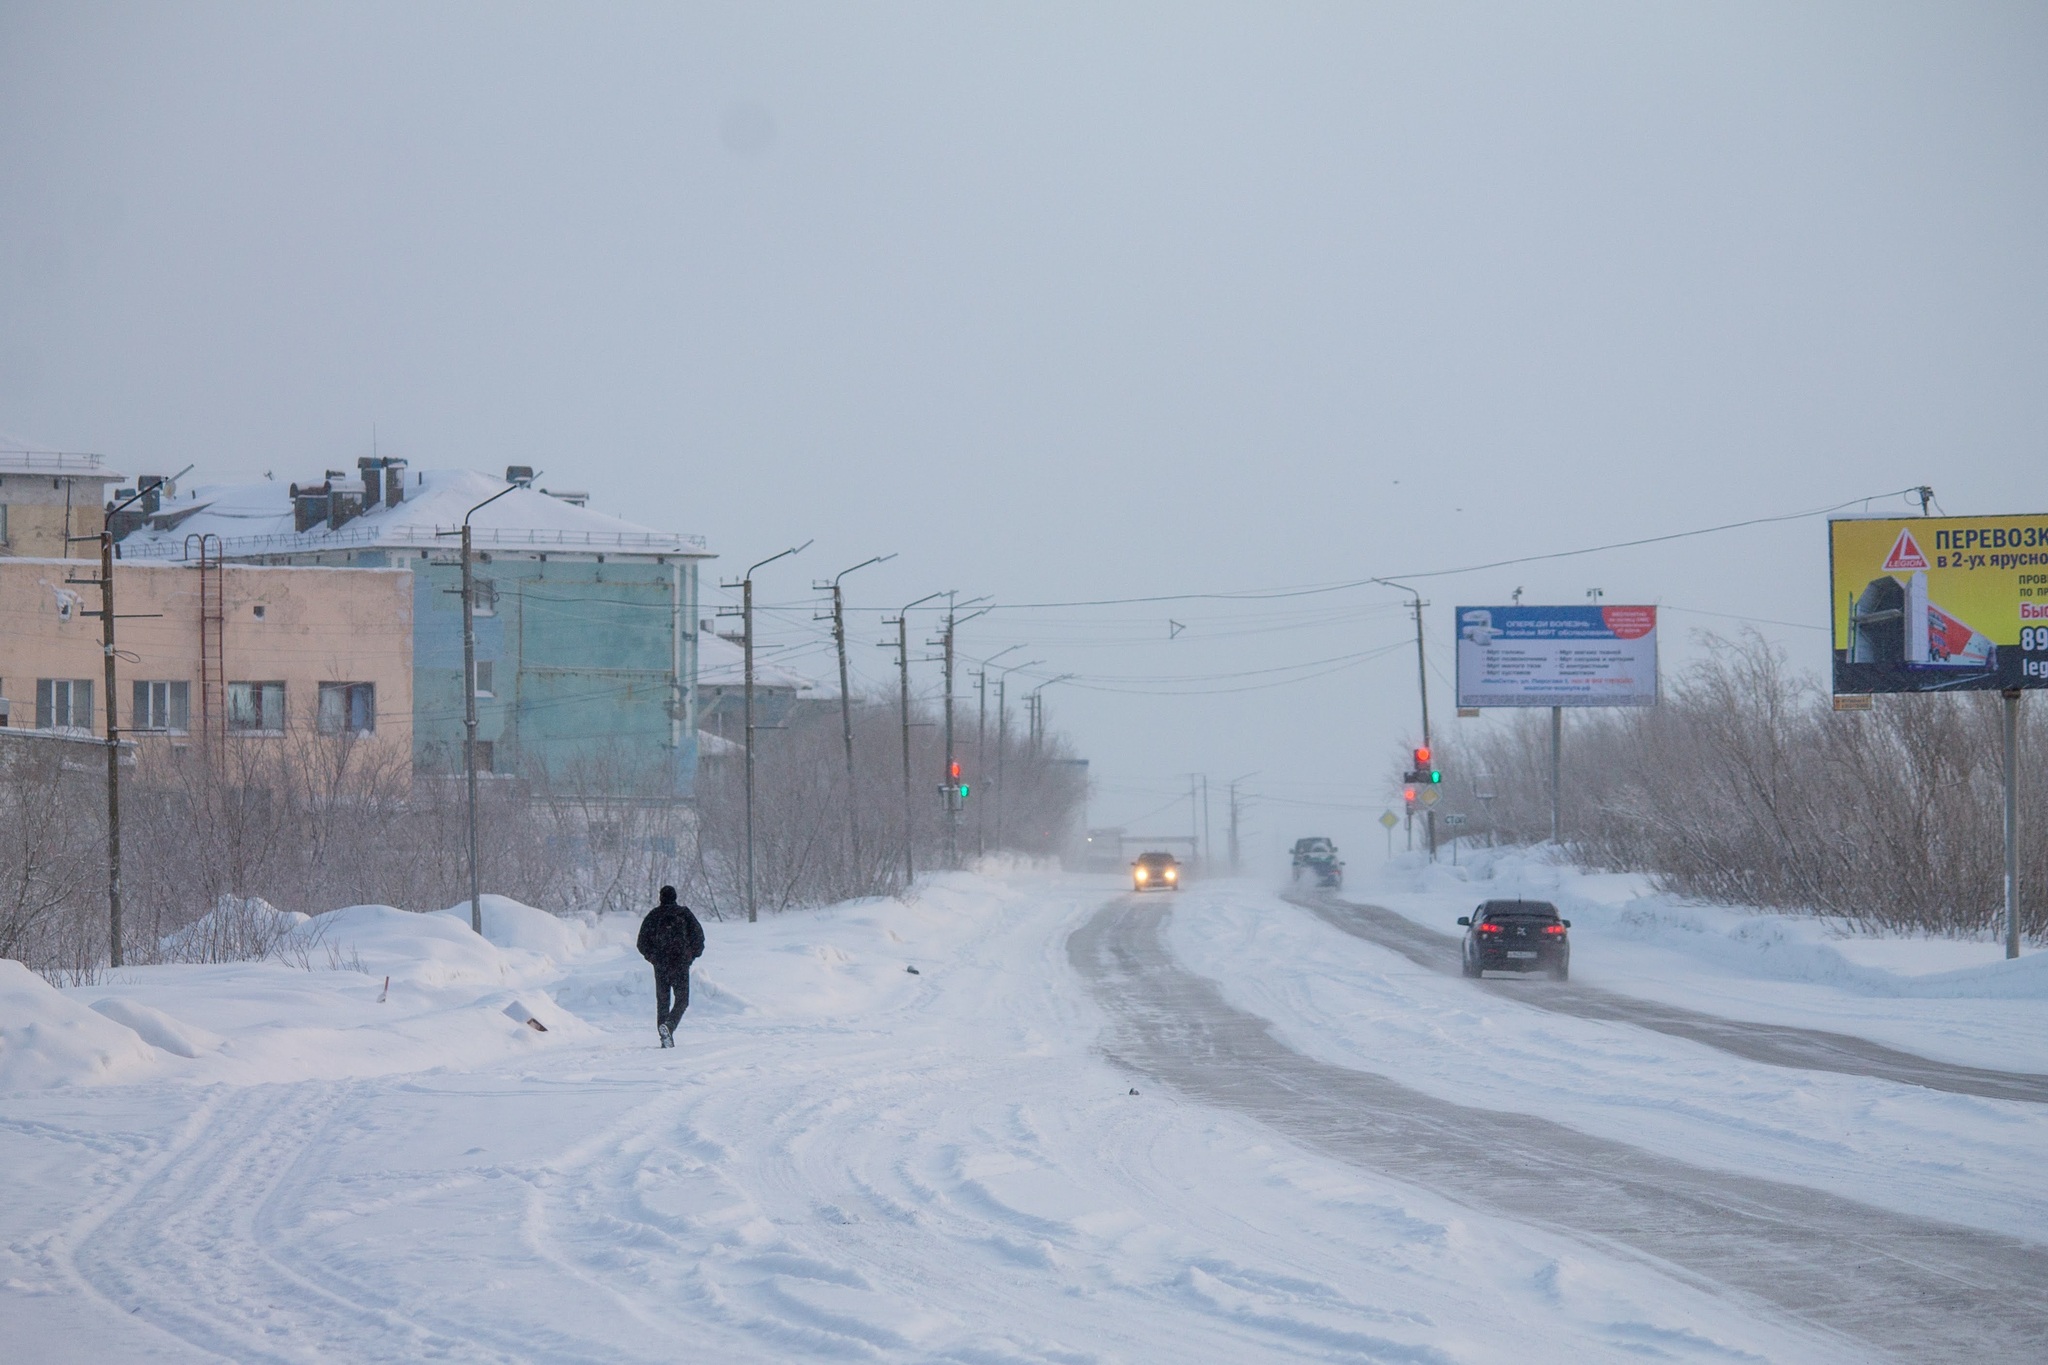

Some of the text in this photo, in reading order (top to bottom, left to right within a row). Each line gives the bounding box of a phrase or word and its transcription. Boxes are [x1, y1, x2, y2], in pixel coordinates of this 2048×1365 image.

[1936, 527, 2048, 550] ПЕРЕВОЗК
[1887, 560, 1923, 568] LEGION
[1937, 552, 2048, 571] в 2-ух ярусно
[2021, 627, 2048, 651] 89
[2022, 658, 2048, 679] leg
